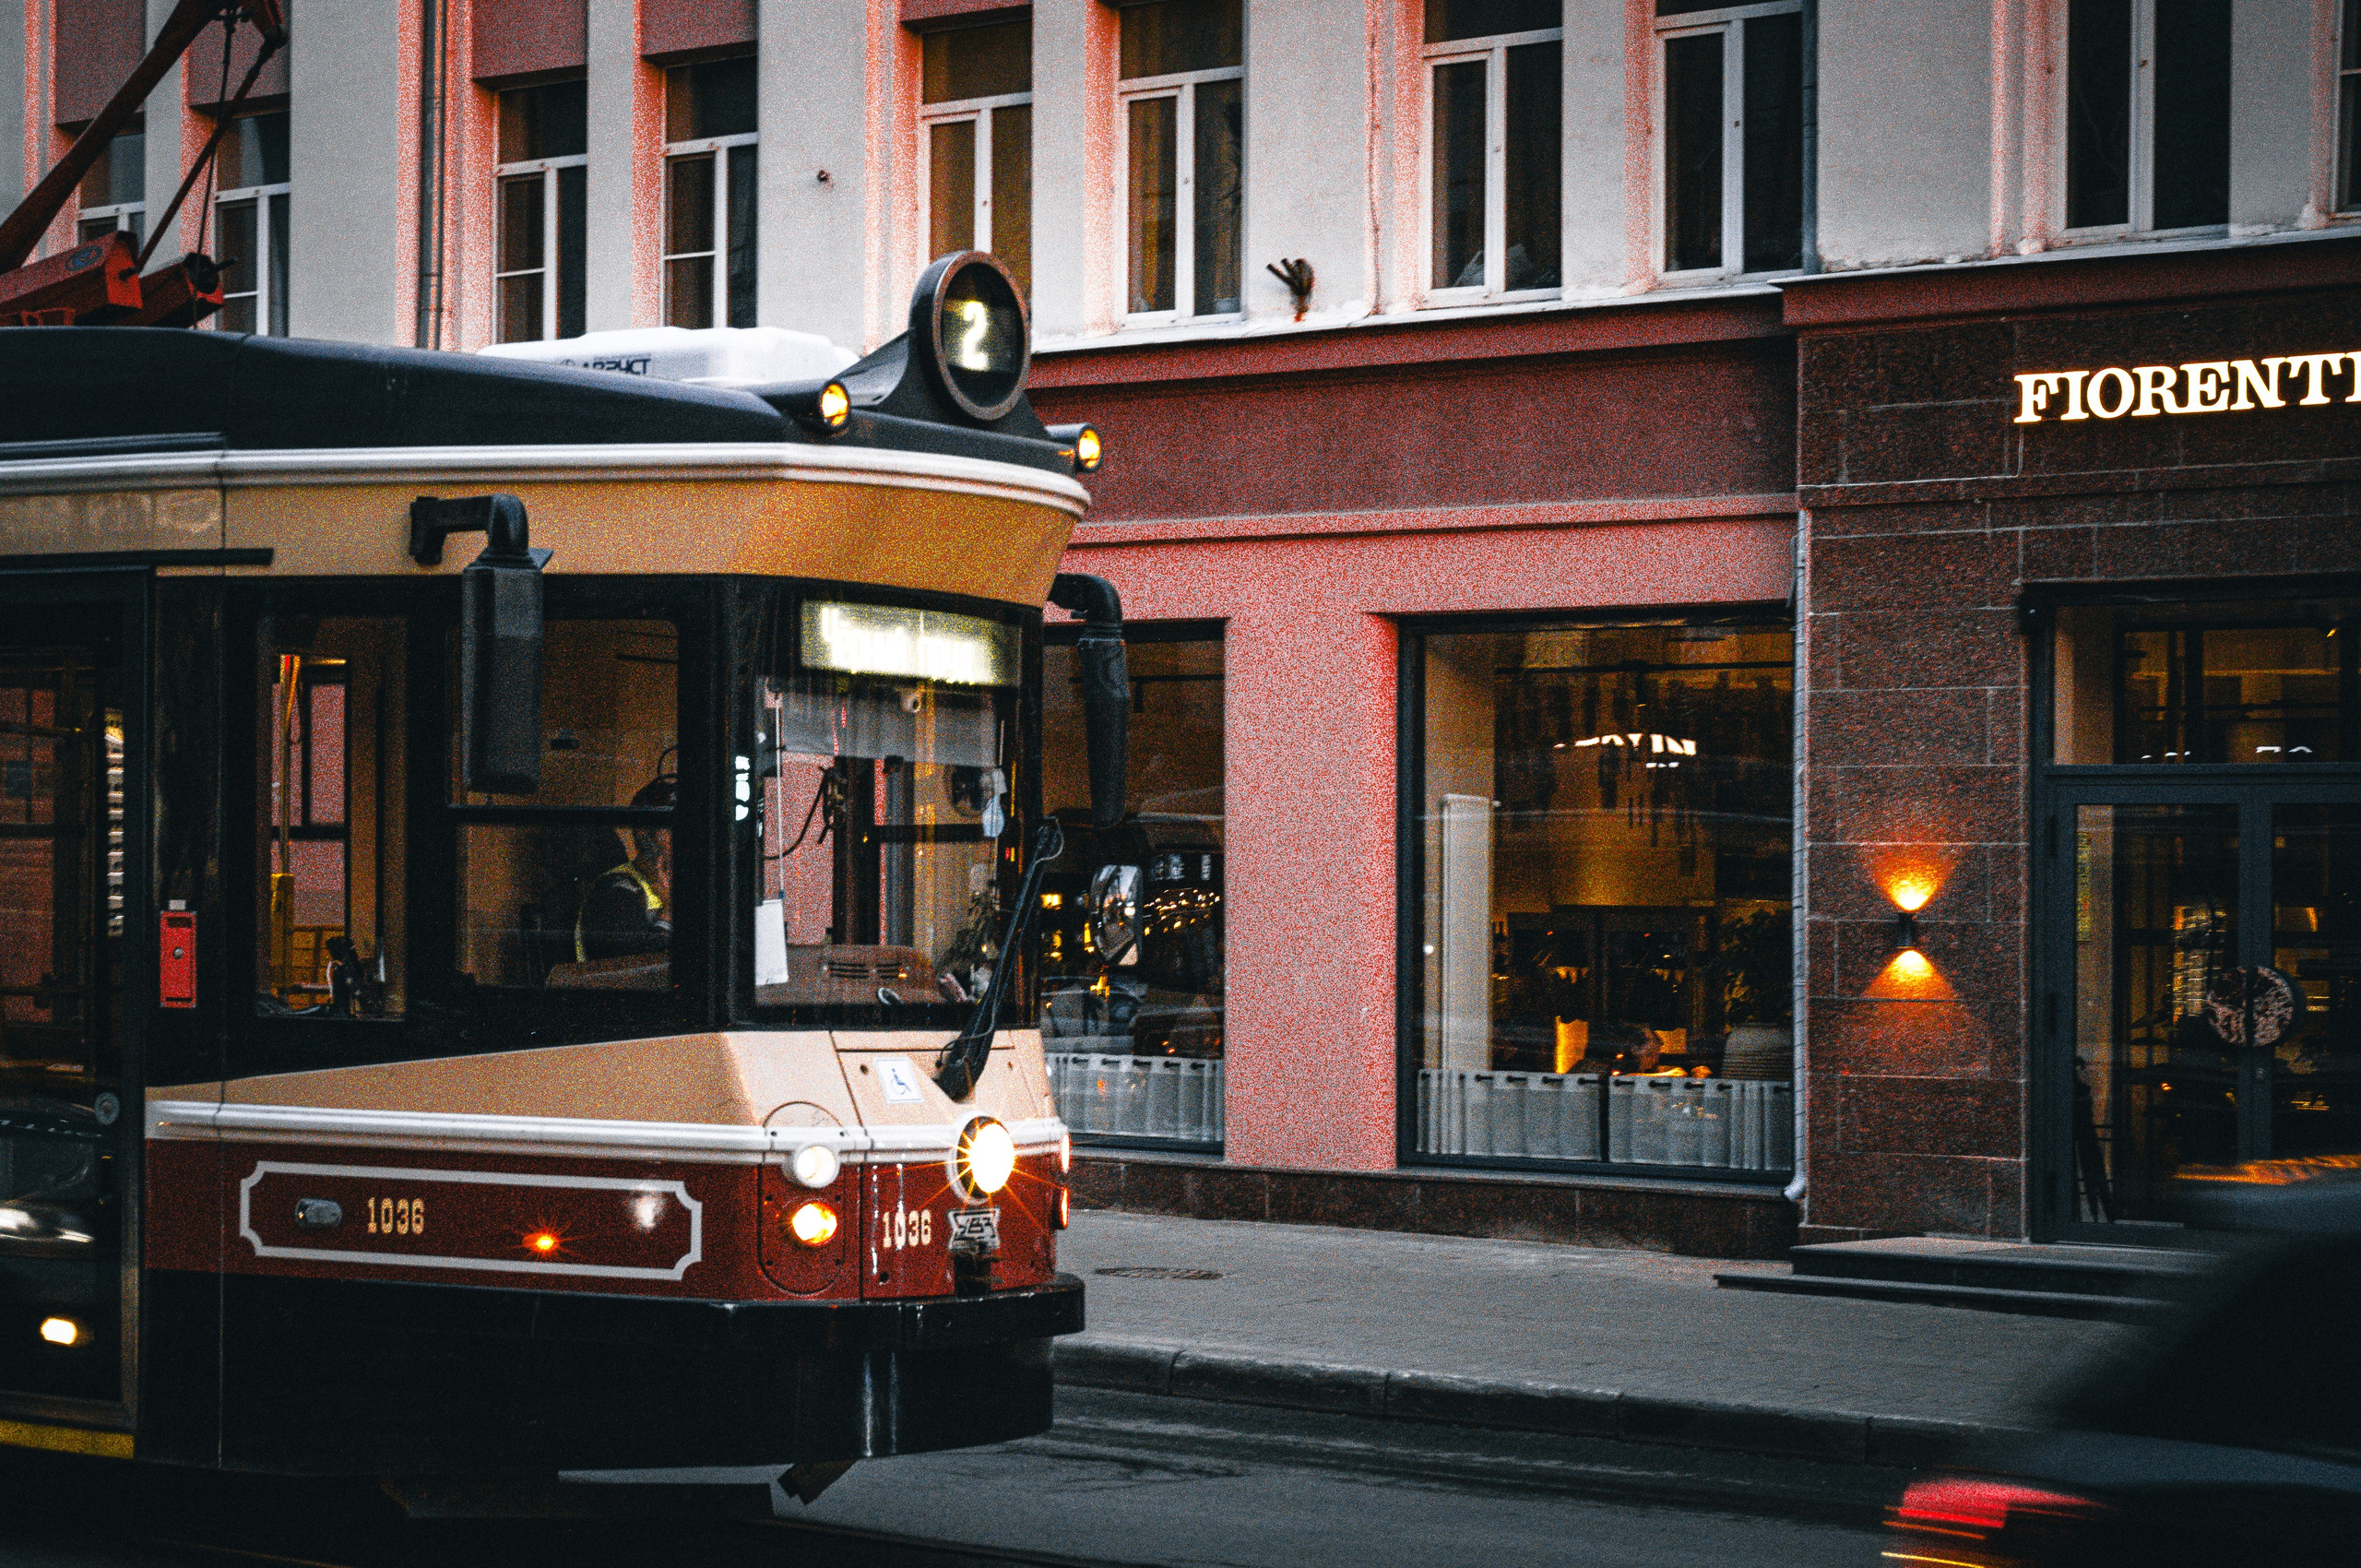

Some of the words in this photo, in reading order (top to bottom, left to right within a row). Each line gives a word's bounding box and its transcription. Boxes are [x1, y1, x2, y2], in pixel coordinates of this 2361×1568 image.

[963, 301, 989, 371] 2
[368, 1197, 424, 1234] 1036
[883, 1208, 931, 1249] 1036
